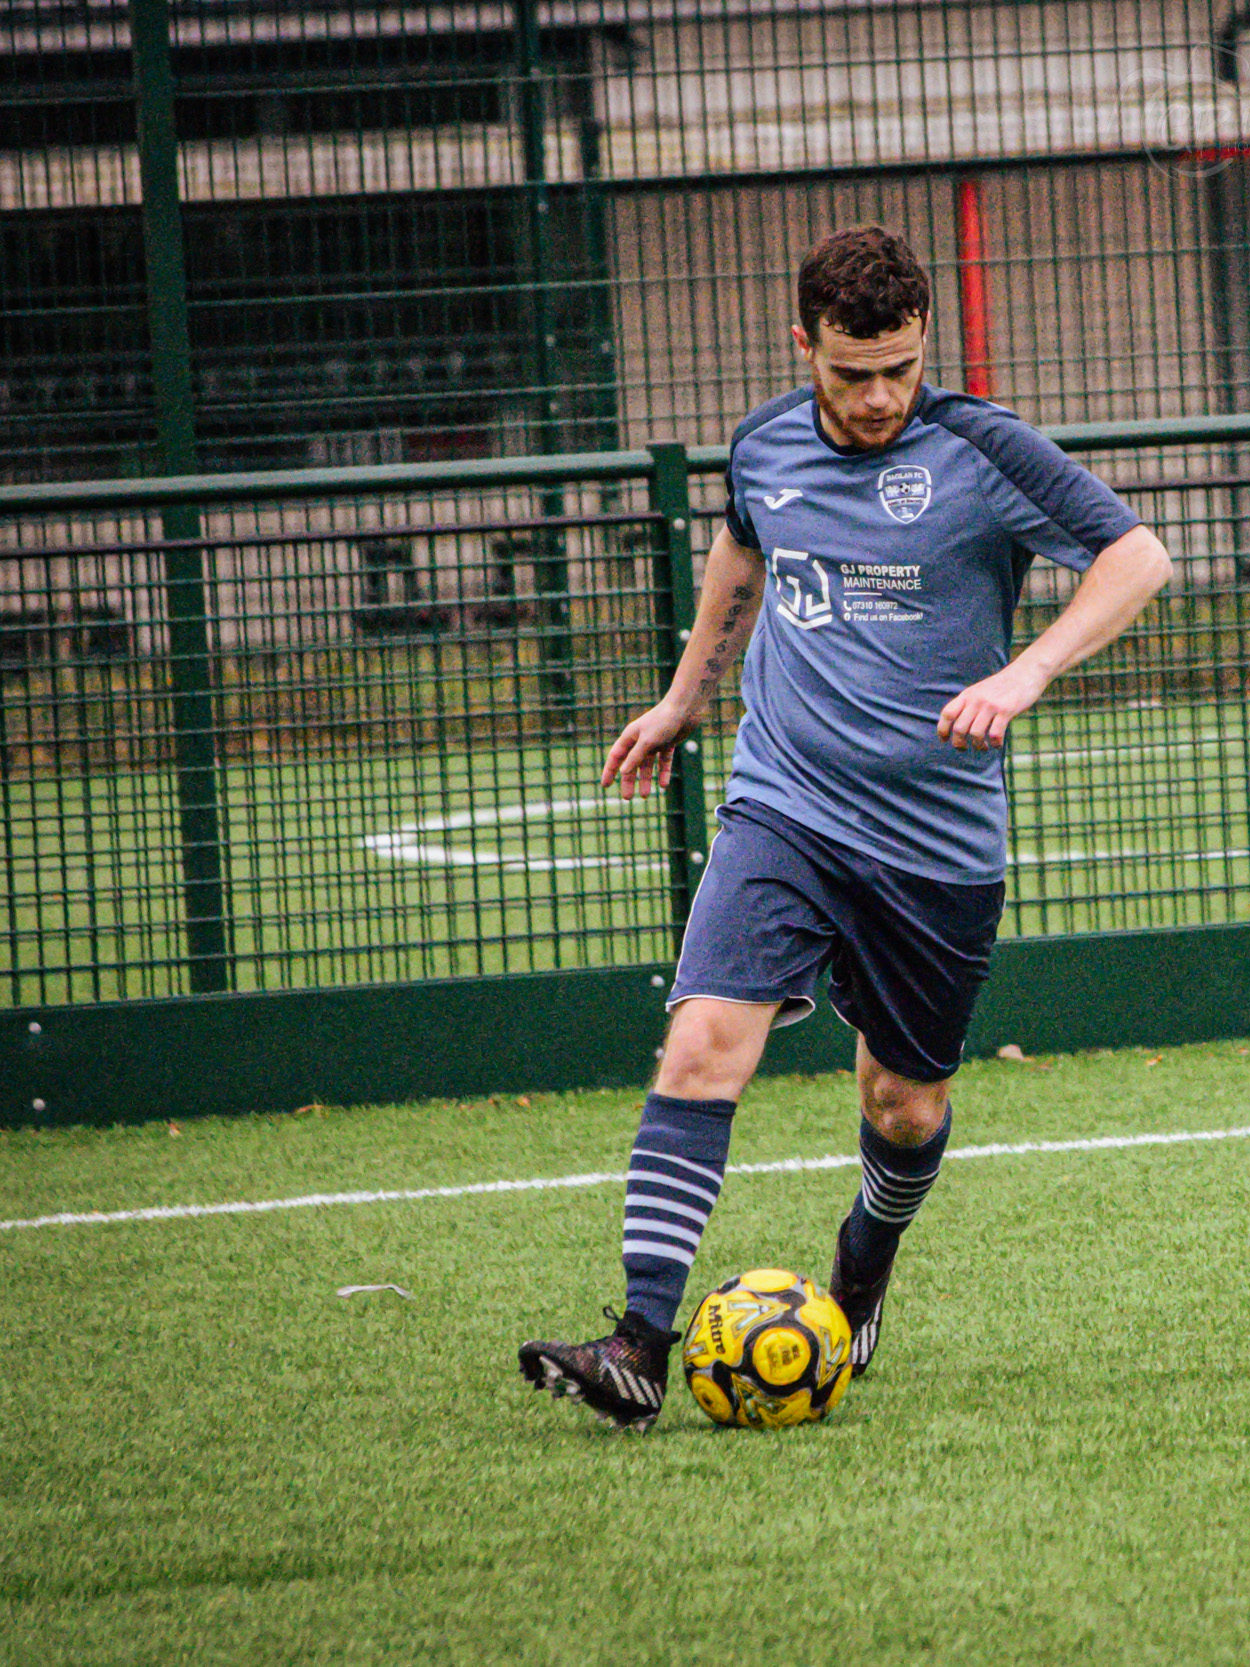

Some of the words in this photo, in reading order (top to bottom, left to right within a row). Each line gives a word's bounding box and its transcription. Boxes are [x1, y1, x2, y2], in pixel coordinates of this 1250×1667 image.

[914, 471, 923, 479] FC
[840, 563, 856, 575] GJ
[857, 564, 920, 577] PROPERTY
[843, 577, 922, 590] MAINTENANCE
[853, 612, 869, 621] Find
[709, 1304, 726, 1354] Mitre
